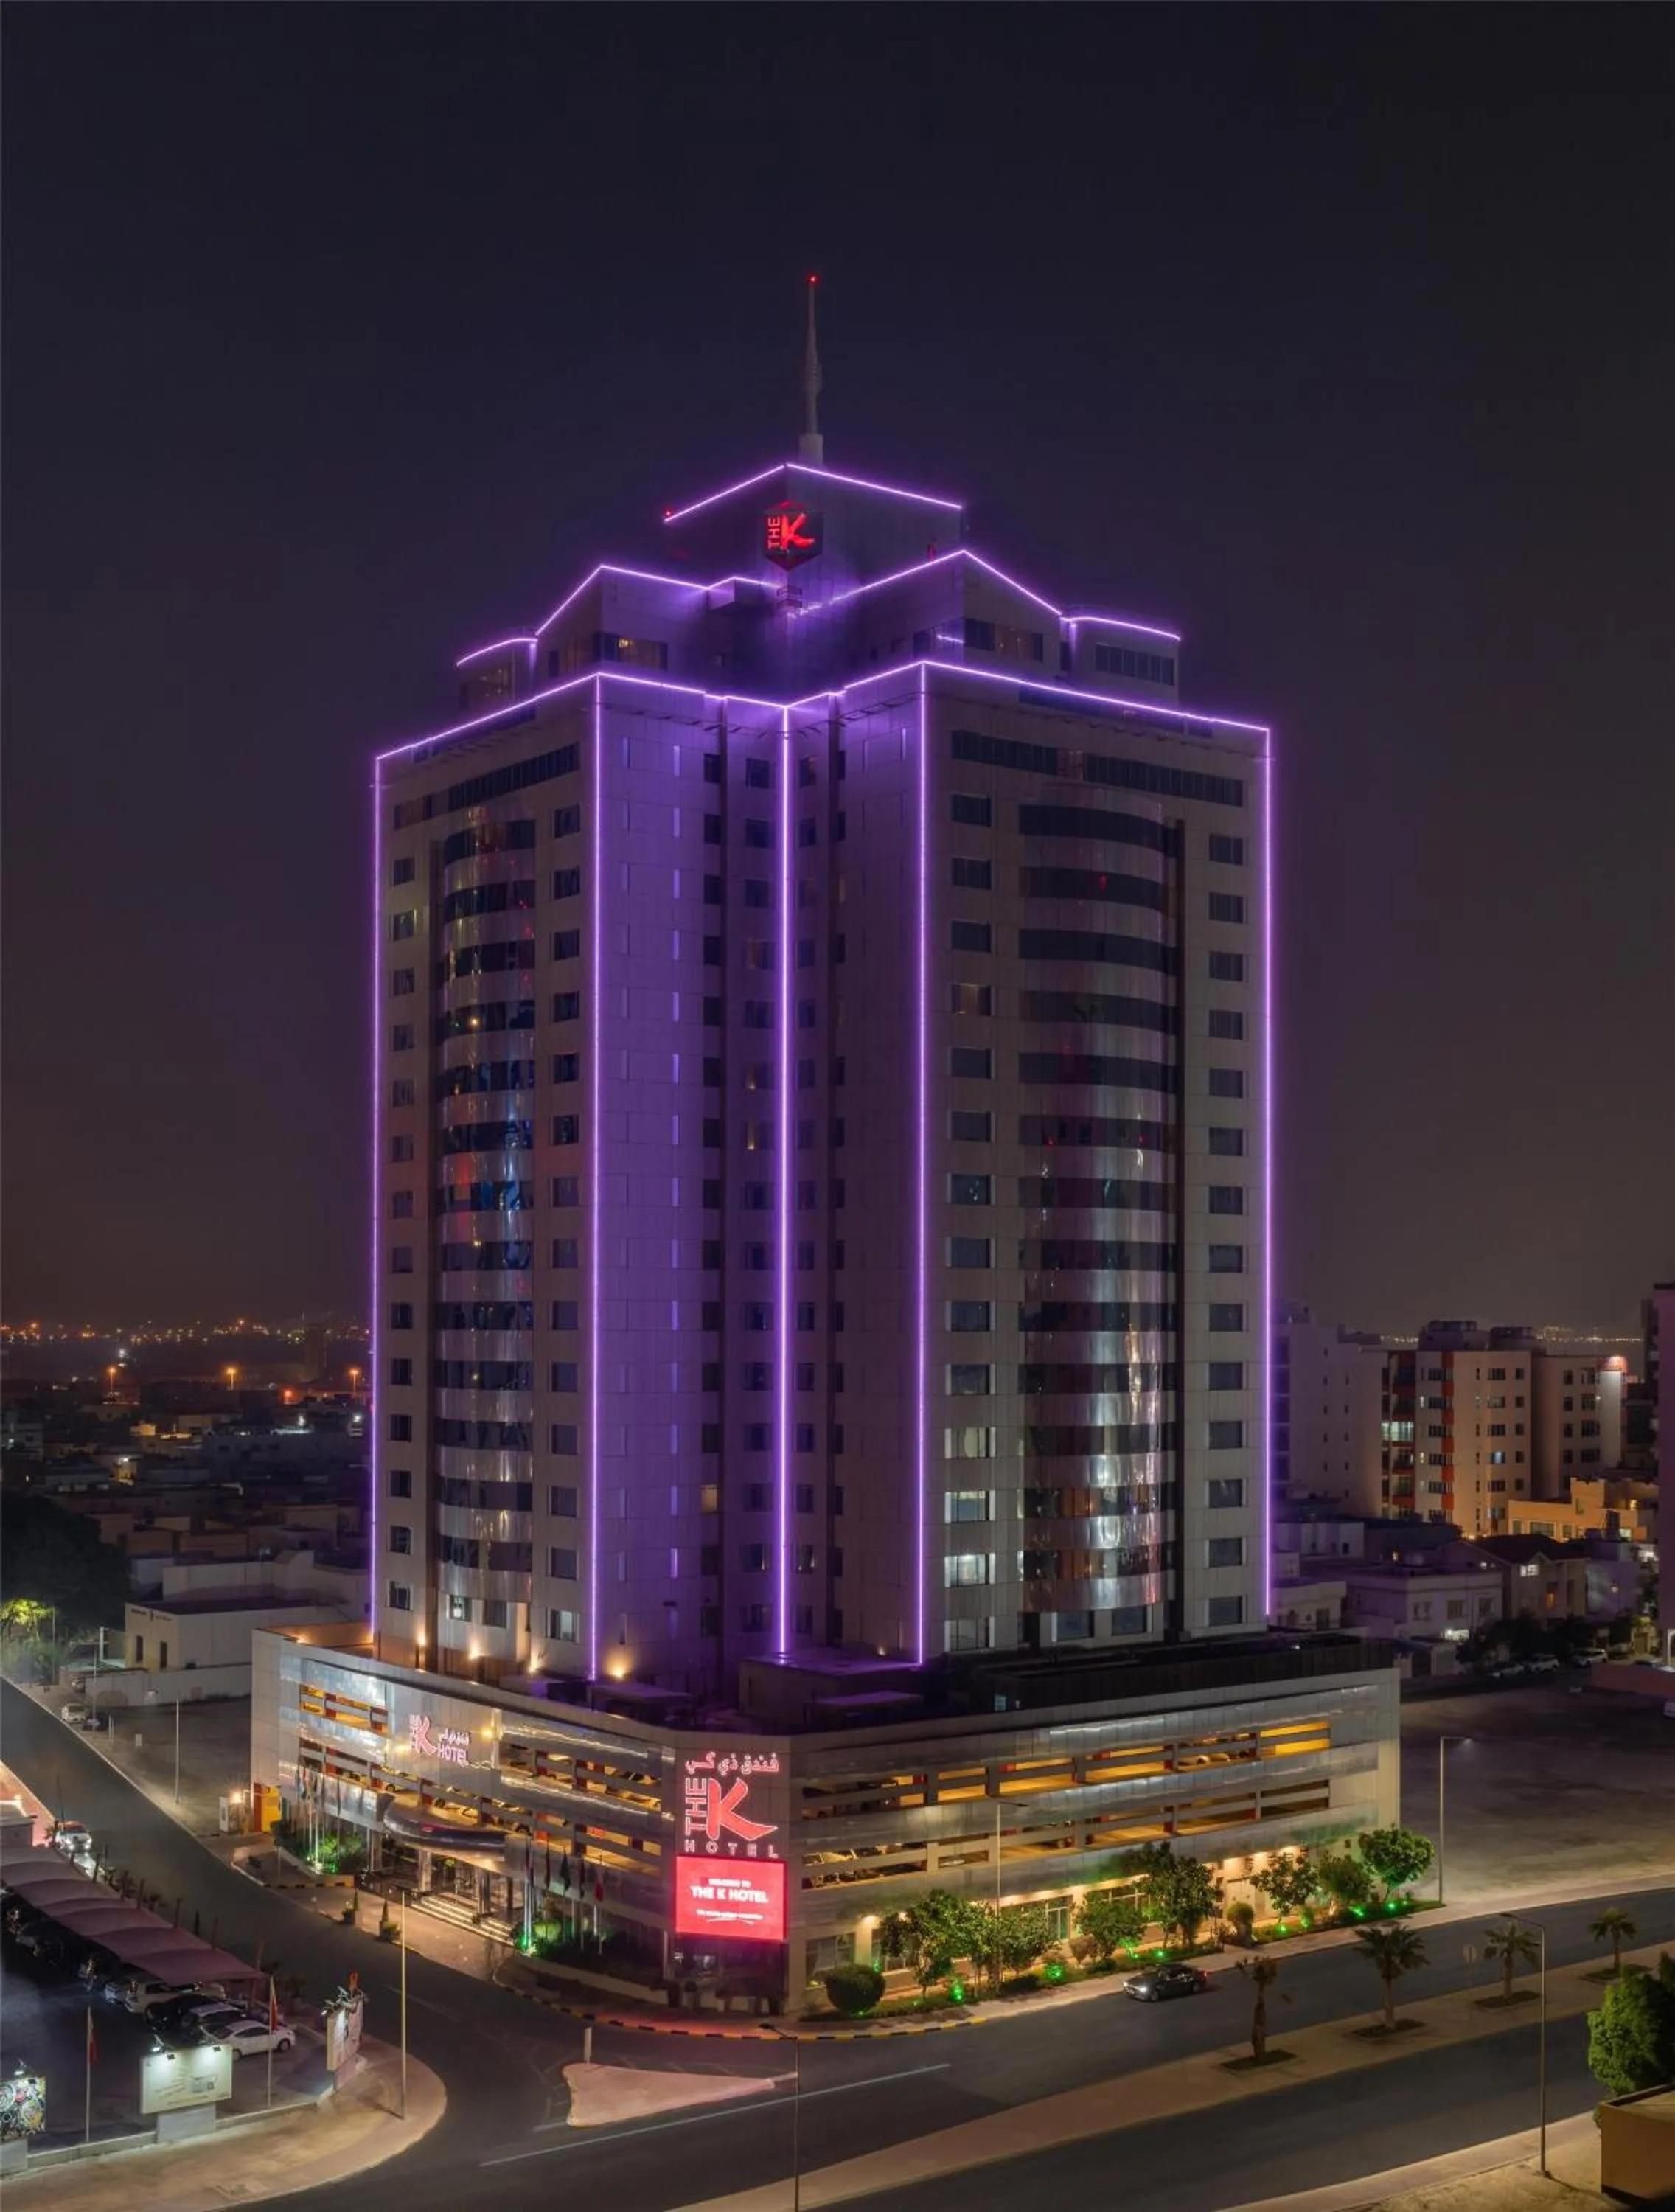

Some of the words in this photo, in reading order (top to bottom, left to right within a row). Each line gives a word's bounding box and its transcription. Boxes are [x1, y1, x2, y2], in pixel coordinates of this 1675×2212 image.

[767, 517, 781, 549] THE
[781, 513, 815, 550] K
[415, 1715, 437, 1755] K
[437, 1742, 468, 1765] HOTEL
[741, 1752, 779, 1775] فندق
[685, 1778, 707, 1836] THE
[706, 1777, 779, 1841] K
[685, 1840, 779, 1859] HOTEL
[690, 1885, 714, 1899] THE
[717, 1888, 726, 1900] K
[728, 1888, 770, 1904] HOTEL
